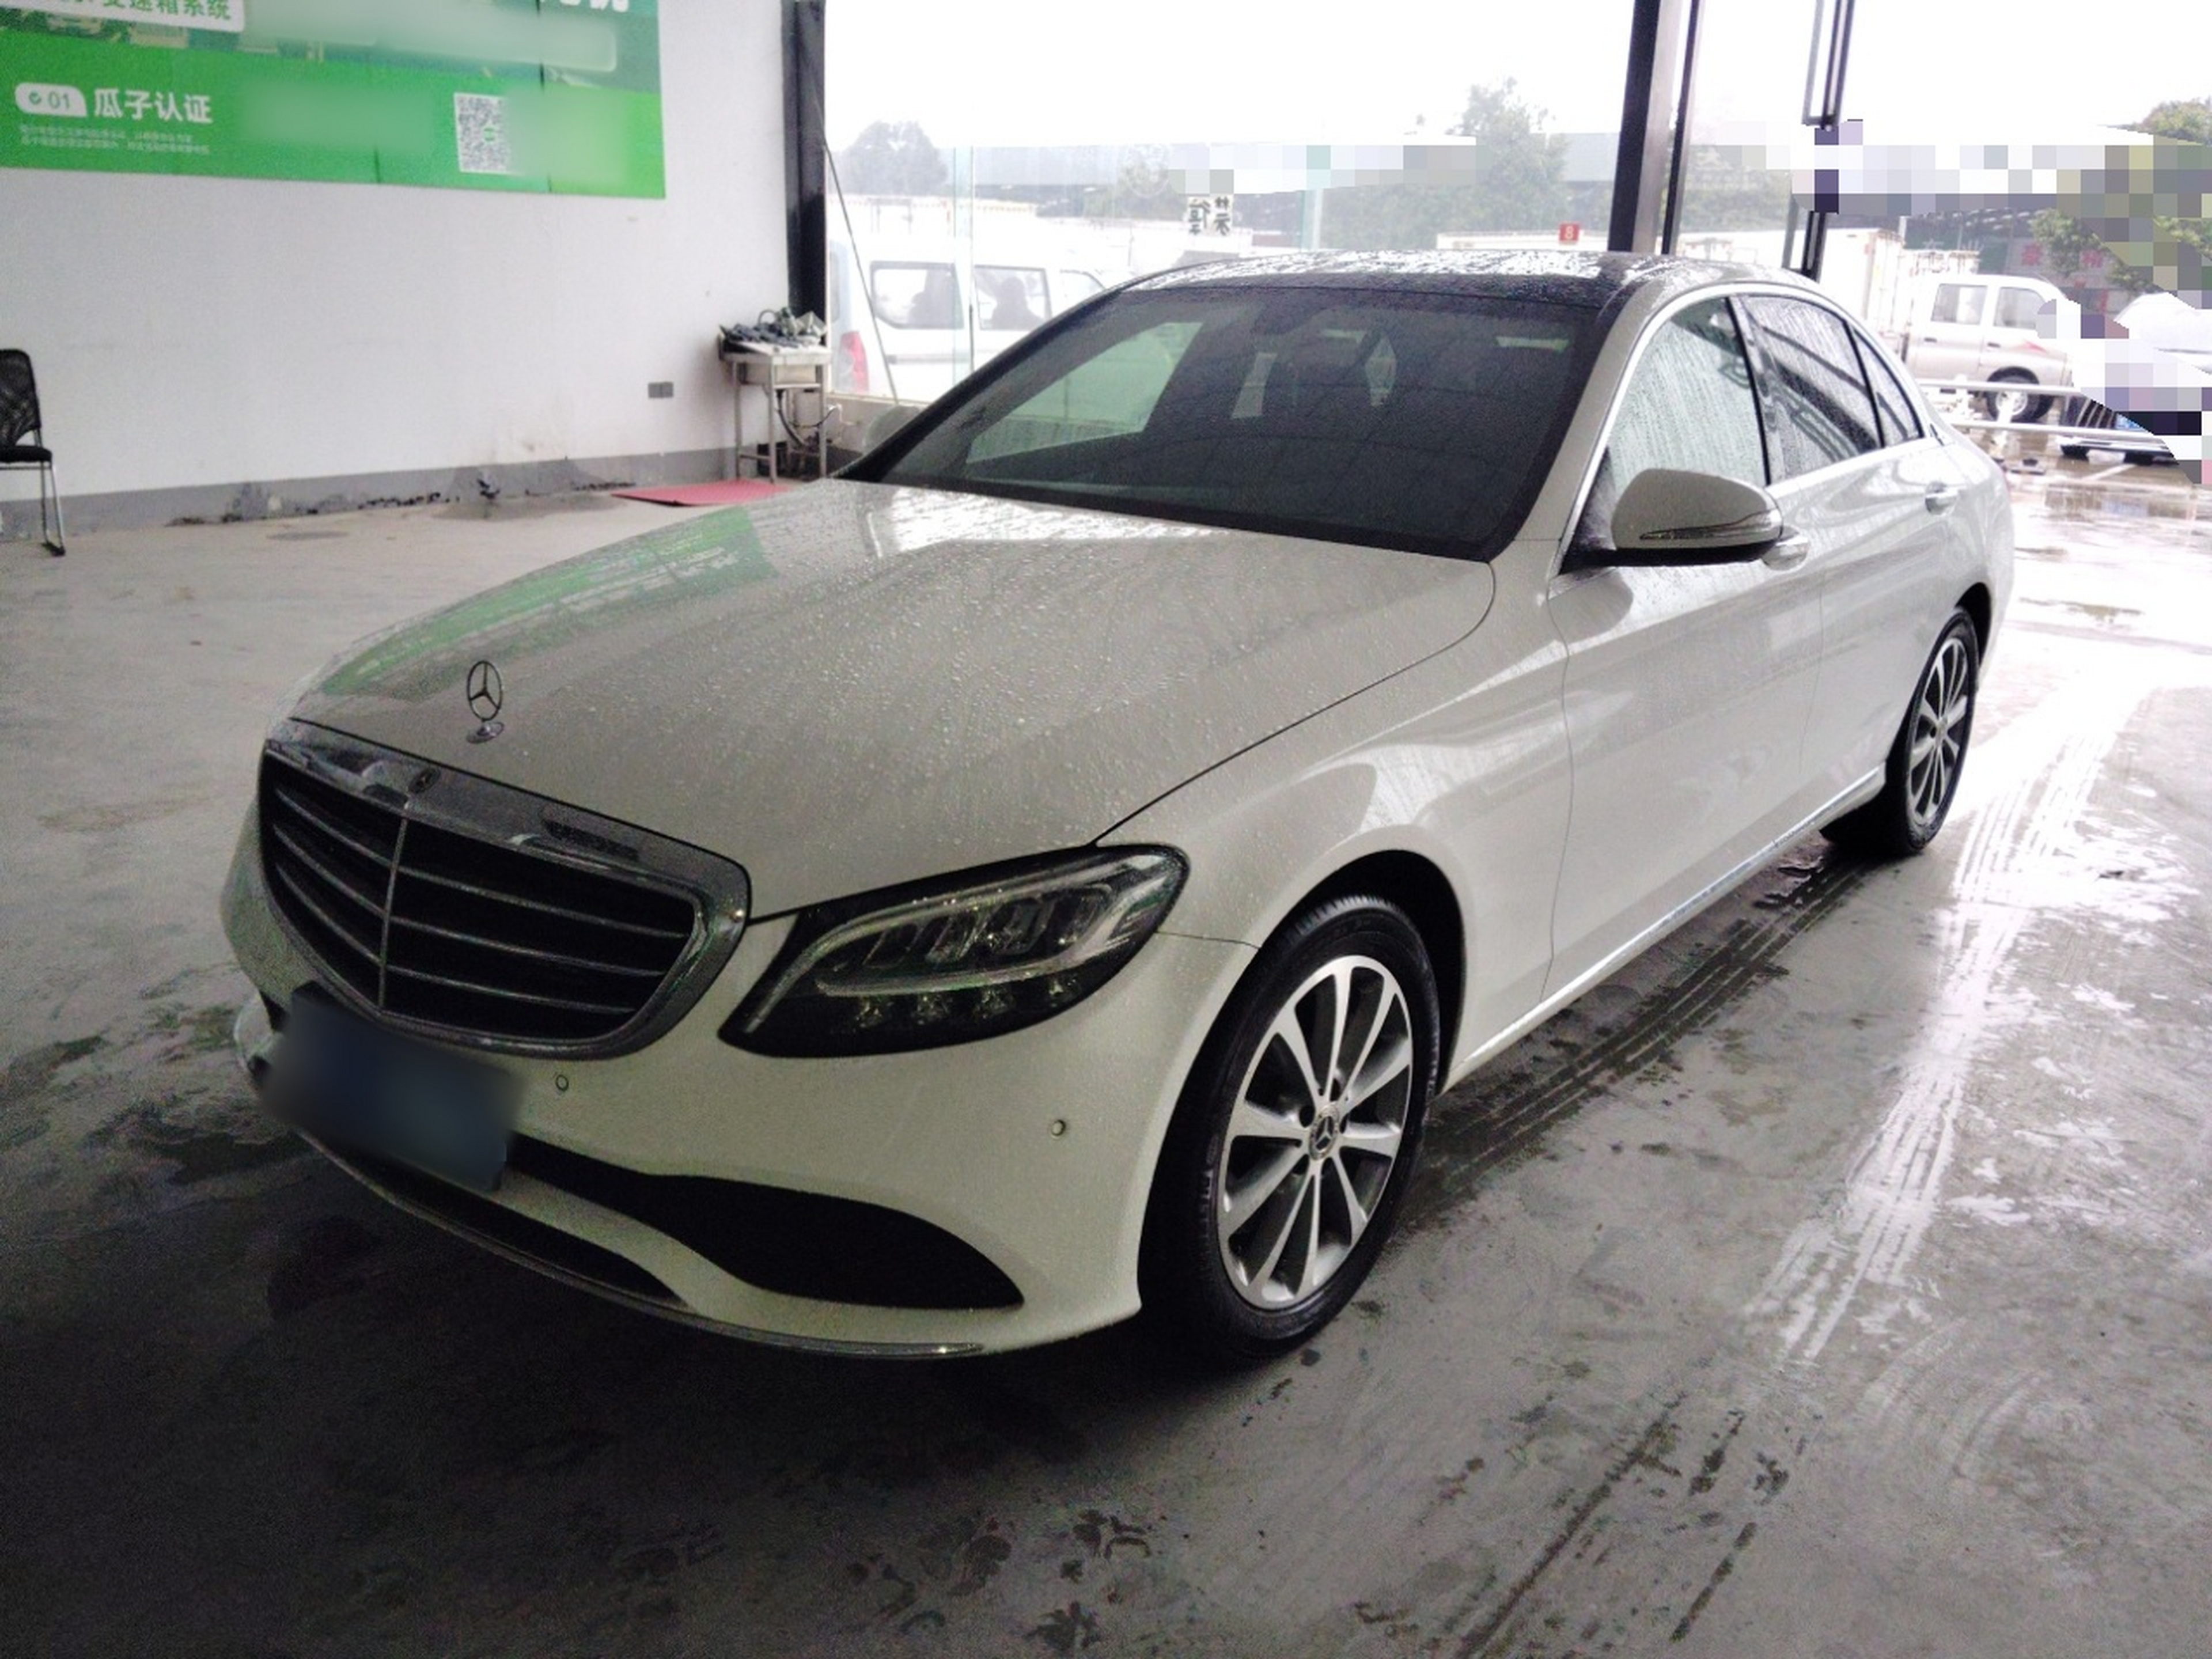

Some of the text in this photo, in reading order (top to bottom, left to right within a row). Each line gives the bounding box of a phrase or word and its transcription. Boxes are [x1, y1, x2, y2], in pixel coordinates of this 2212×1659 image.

[48, 88, 213, 124] 01 瓜子认证
[1565, 225, 1574, 240] 8
